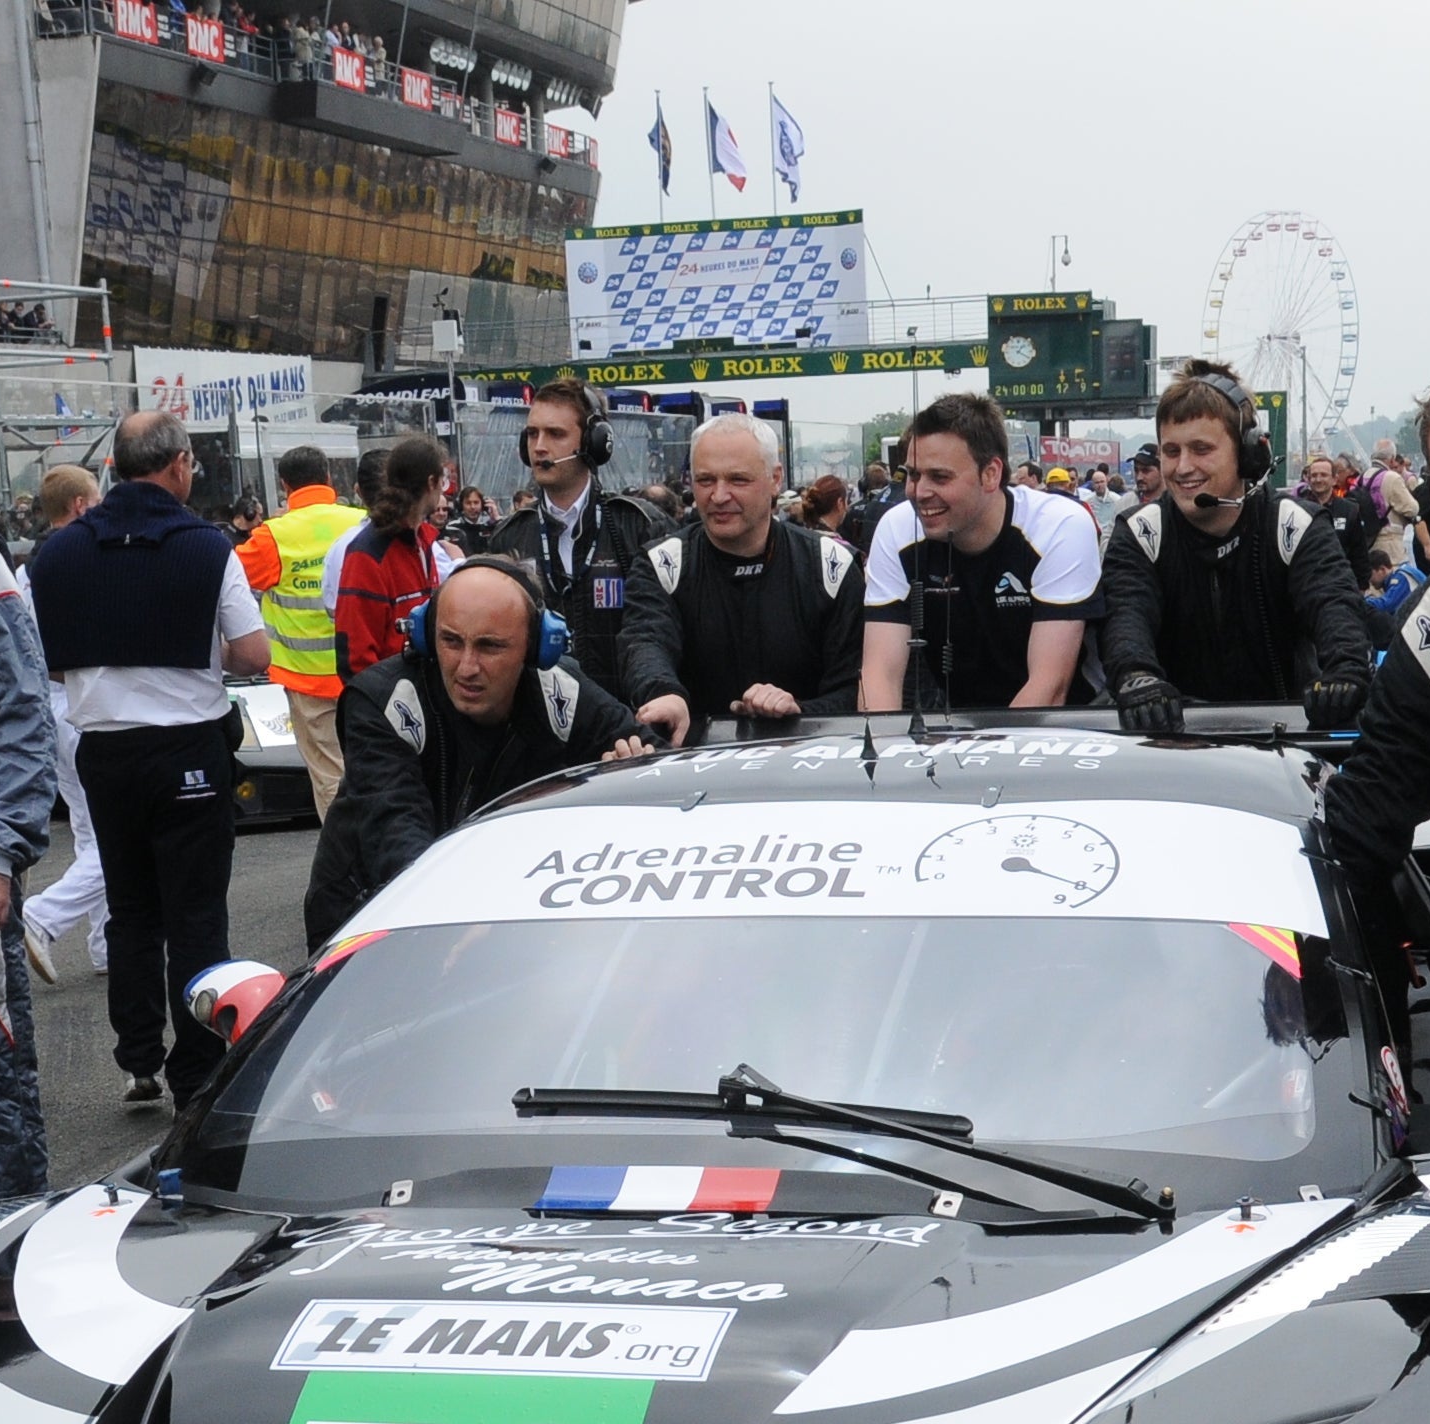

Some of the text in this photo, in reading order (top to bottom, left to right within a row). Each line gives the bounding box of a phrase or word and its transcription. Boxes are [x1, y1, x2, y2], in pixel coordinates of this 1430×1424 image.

[115, 0, 156, 40] RMC
[187, 20, 221, 57] RMC
[335, 53, 361, 87] RMC
[403, 74, 430, 107] RMC
[496, 112, 519, 142] RMC
[596, 214, 838, 237] ROLEX ROLEX ROLEX ROLEX
[679, 264, 699, 276] 24
[727, 261, 737, 269] DU
[1013, 297, 1066, 311] ROLEX
[588, 349, 945, 383] ROLEX ROLEX ROLEX
[152, 364, 305, 421] 24 HEURES DU MANS
[1217, 536, 1240, 559] DKR
[291, 560, 309, 573] 24
[734, 563, 764, 577] DKR
[653, 740, 1120, 767] LUC ALPHAND
[635, 755, 1103, 779] AVENTURES
[986, 826, 998, 835] 3
[1024, 822, 1036, 832] 4
[1062, 830, 1073, 840] 5
[953, 838, 964, 846] 2
[1083, 841, 1096, 853] 6
[525, 832, 863, 880] Adrenaline
[935, 854, 946, 862] 1
[934, 872, 946, 880] 0
[1092, 863, 1106, 874] 7
[537, 866, 867, 909] CONTROL
[1053, 893, 1068, 905] 9
[290, 1214, 592, 1277] Groupe
[381, 1242, 699, 1267] Automobiles
[442, 1261, 789, 1302] Monaco
[314, 1316, 700, 1368] LE MANS .org
